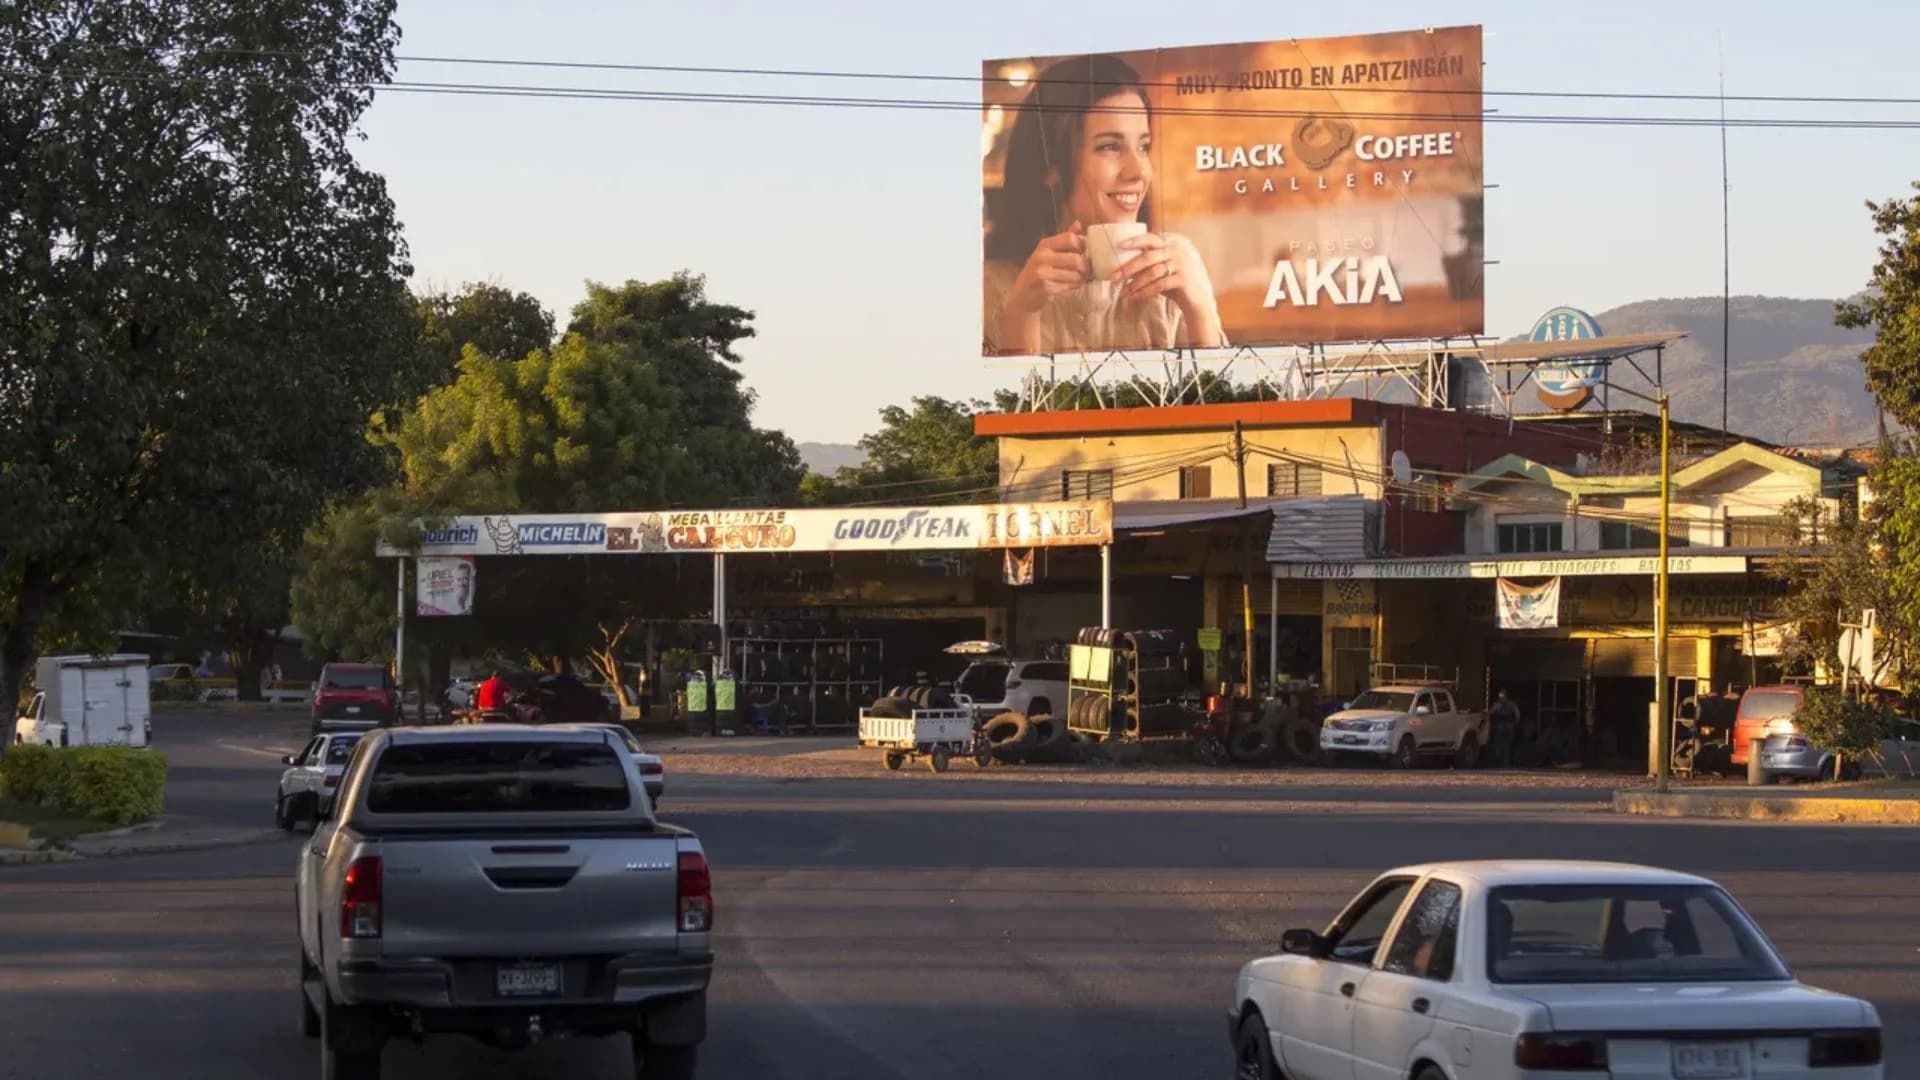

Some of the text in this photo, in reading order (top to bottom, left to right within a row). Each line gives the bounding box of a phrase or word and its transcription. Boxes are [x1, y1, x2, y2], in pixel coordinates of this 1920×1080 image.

[1176, 51, 1465, 96] MUY PRONTO EN APATZINGÁN
[1195, 143, 1285, 171] BLACK
[1235, 170, 1413, 194] GALLERY
[1289, 236, 1375, 254] PASEO
[668, 511, 786, 526] MEGA LLANTAS
[986, 509, 1101, 538] TORNEL
[606, 525, 797, 550] EL CANGURO
